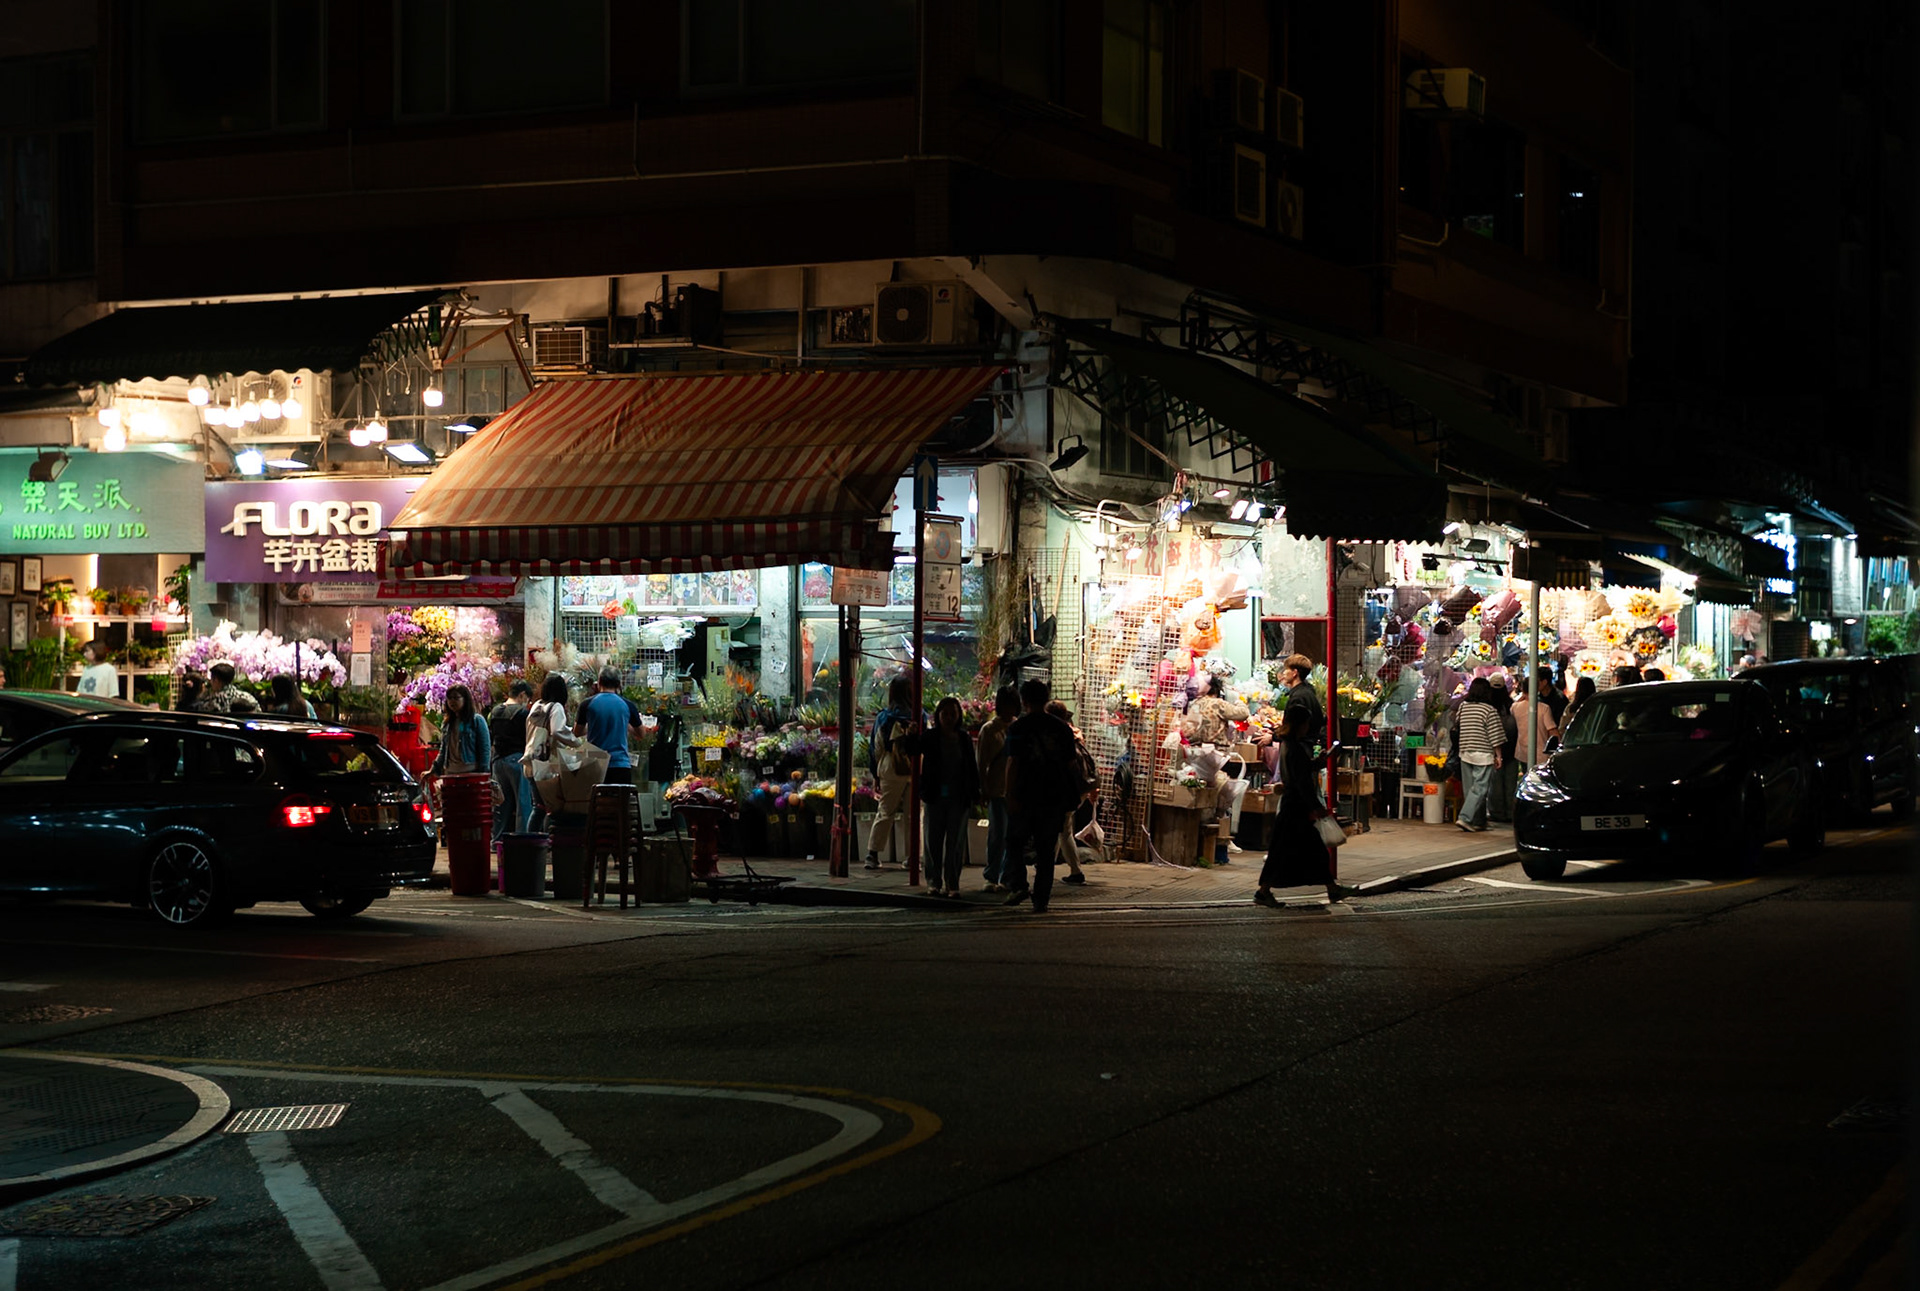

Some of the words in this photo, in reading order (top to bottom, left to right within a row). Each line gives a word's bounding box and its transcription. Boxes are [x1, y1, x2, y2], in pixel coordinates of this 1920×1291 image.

[13, 523, 76, 540] NATURAL
[83, 522, 111, 539] BUY
[117, 522, 150, 539] LTD.
[947, 568, 953, 584] 7
[839, 583, 882, 599] 而不予警告
[947, 595, 959, 612] 12
[1595, 818, 1611, 828] BE
[1615, 816, 1631, 827] 38
